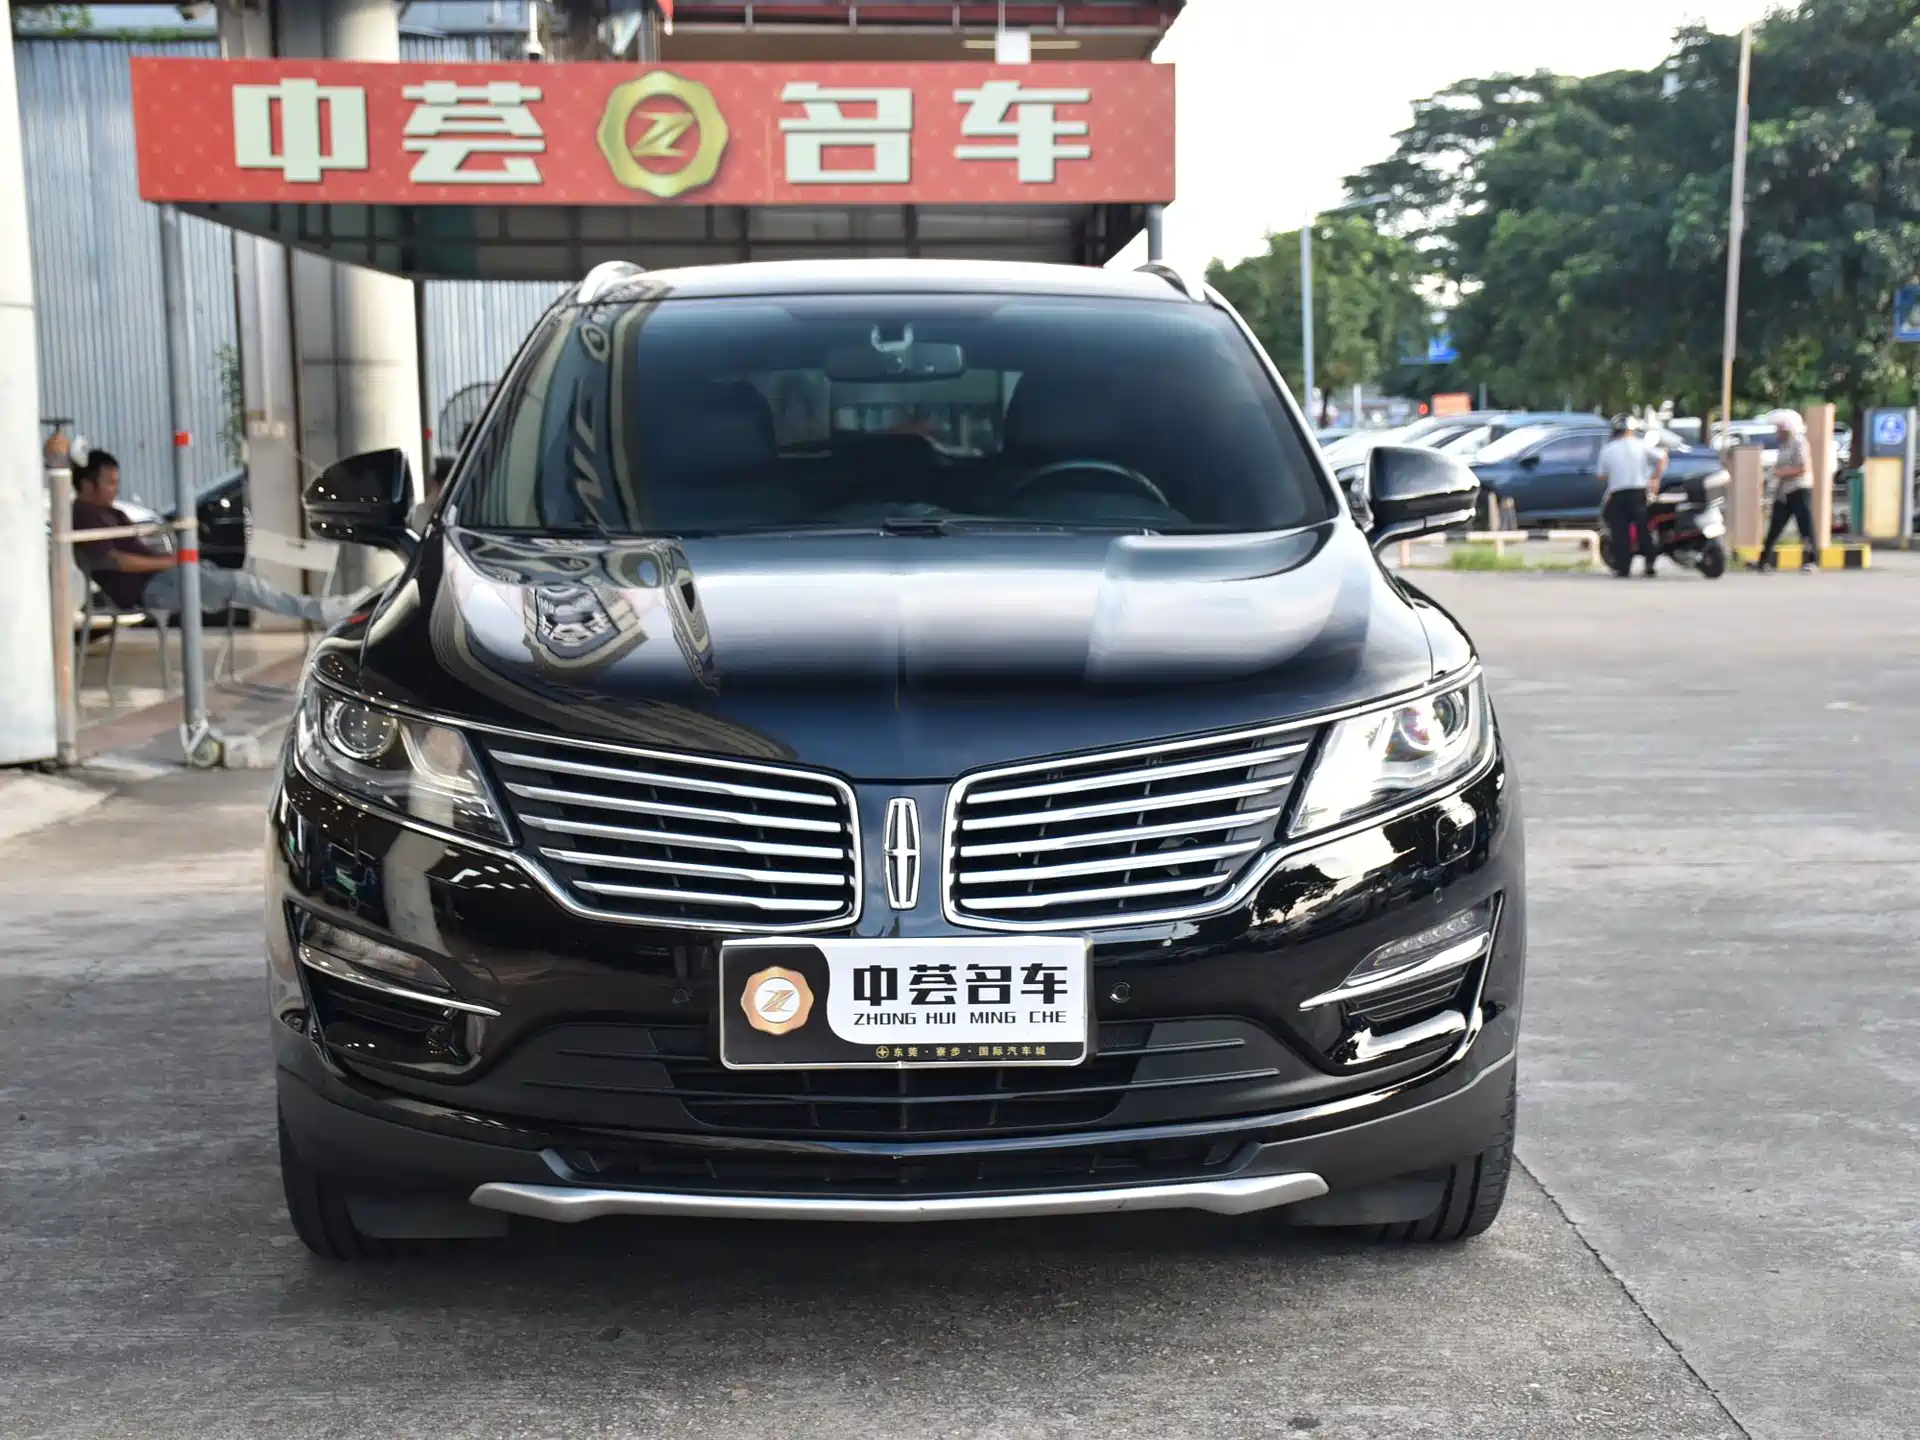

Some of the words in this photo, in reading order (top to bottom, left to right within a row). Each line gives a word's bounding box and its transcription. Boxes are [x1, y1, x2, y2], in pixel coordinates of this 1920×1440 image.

[778, 80, 1093, 184] 名车
[853, 963, 1068, 1006] 中荟名车
[853, 1012, 917, 1025] ZHONG
[926, 1011, 956, 1025] HUI
[970, 1011, 1016, 1024] MING
[1029, 1010, 1067, 1024] CHE
